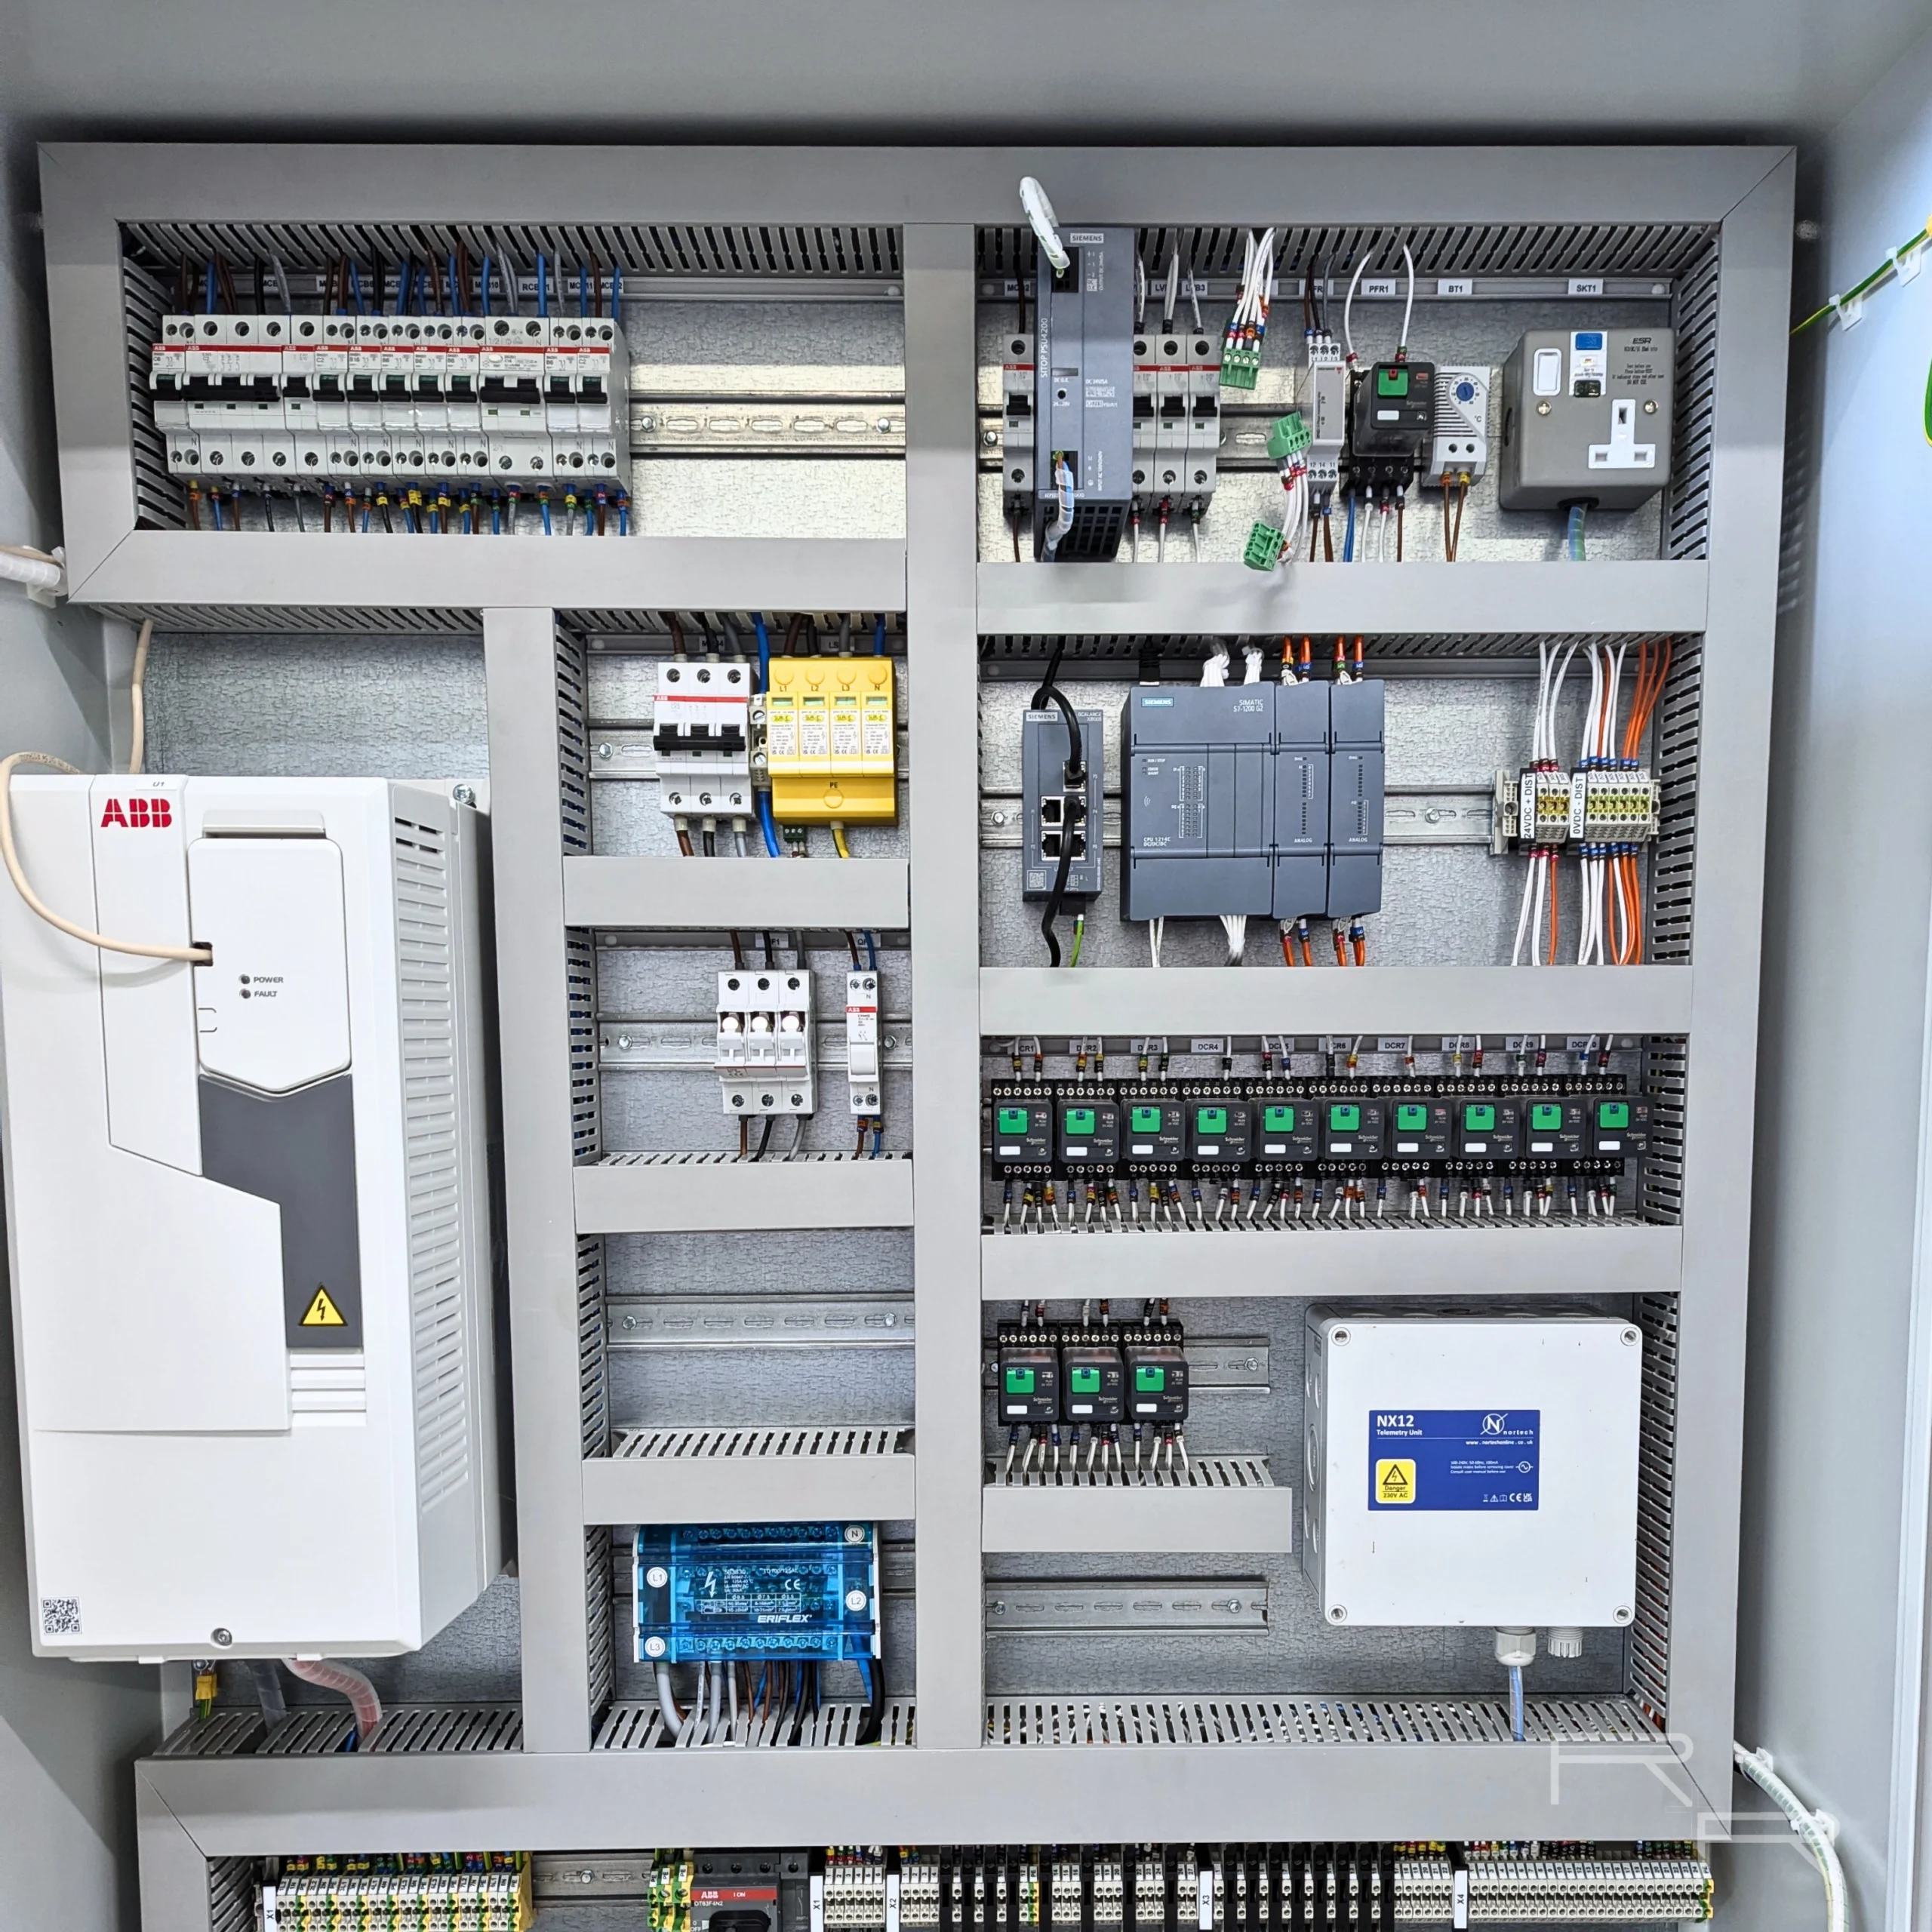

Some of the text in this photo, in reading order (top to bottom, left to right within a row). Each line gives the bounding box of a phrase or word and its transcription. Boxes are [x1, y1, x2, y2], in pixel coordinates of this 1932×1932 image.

[1575, 777, 1583, 798] DIST
[100, 798, 172, 827] ABB
[1524, 808, 1532, 838] 24VDC
[1377, 1415, 1414, 1427] NX12
[653, 1573, 663, 1581] L1
[785, 1579, 800, 1590] CE
[851, 1596, 862, 1604] L2
[650, 1643, 660, 1651] L3
[680, 1869, 685, 1877] PE
[890, 1899, 897, 1909] X2
[1202, 1895, 1210, 1905] X3
[1457, 1894, 1464, 1904] X4
[814, 1900, 820, 1909] X1
[266, 1908, 274, 1919] X1
